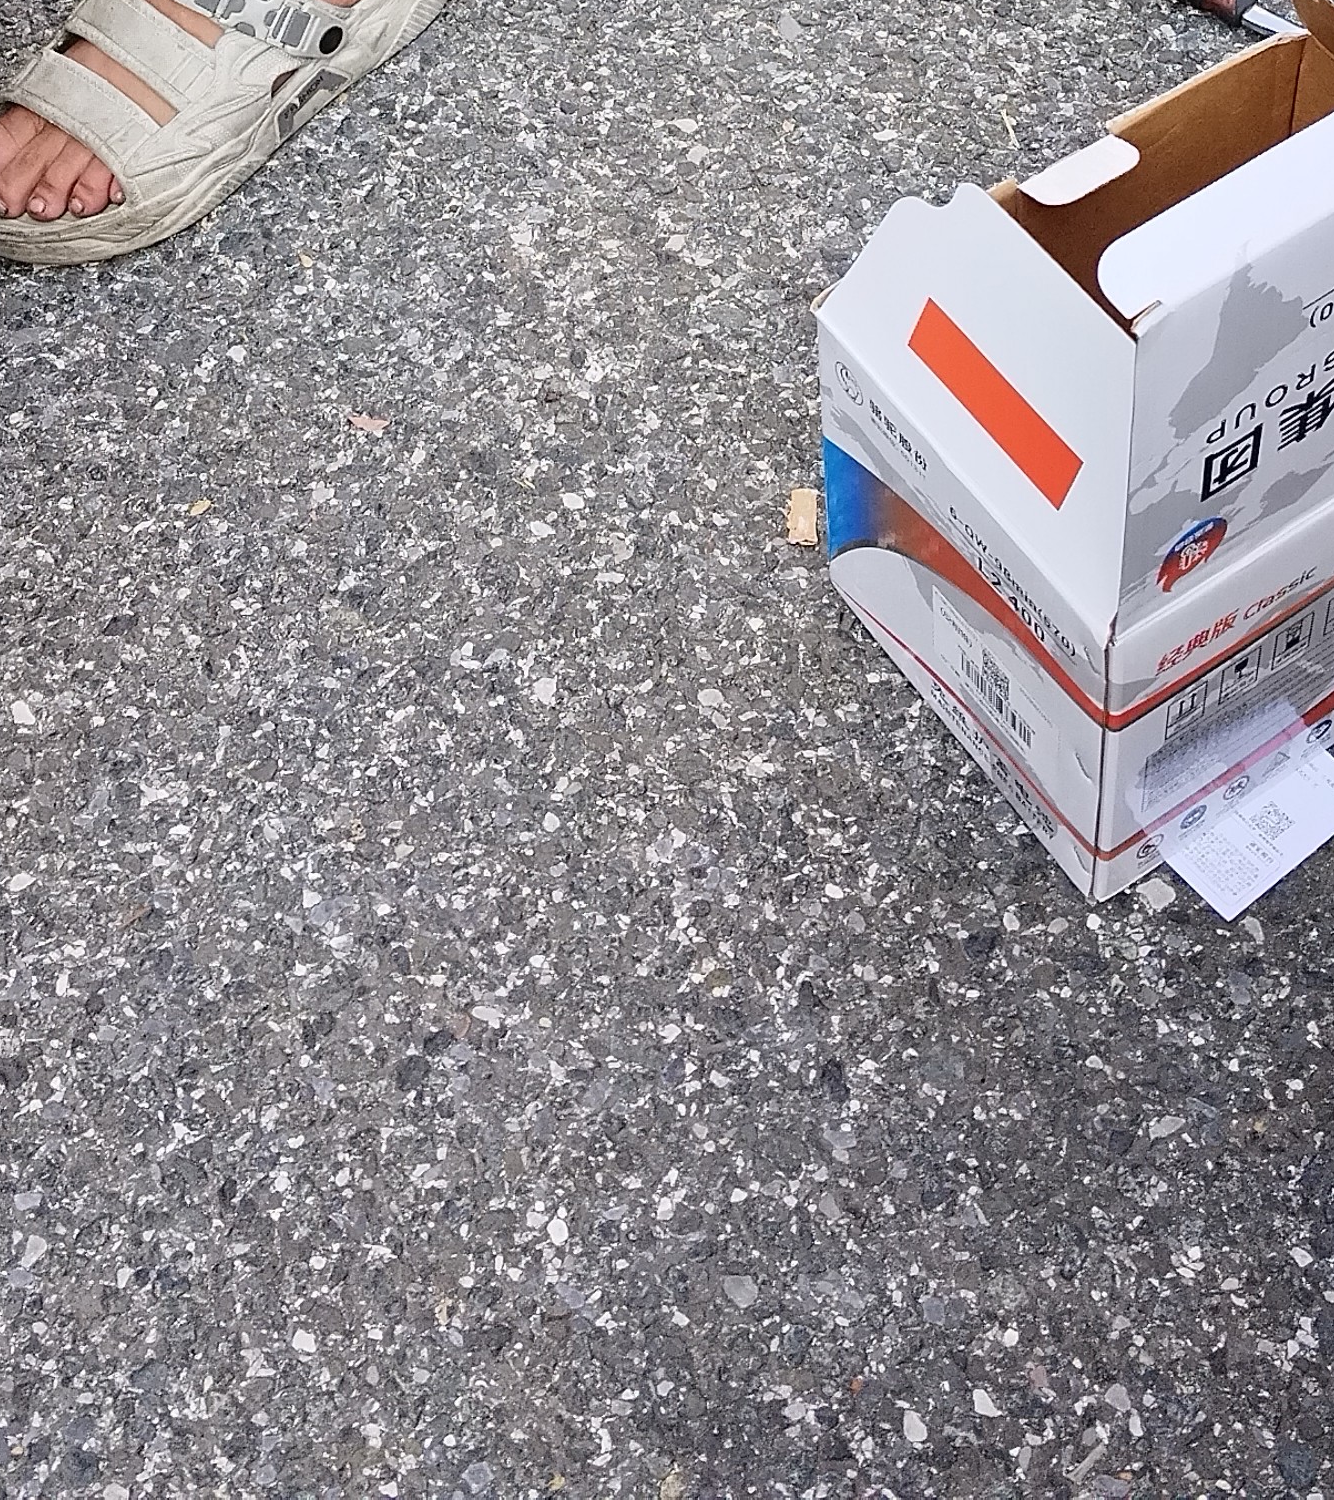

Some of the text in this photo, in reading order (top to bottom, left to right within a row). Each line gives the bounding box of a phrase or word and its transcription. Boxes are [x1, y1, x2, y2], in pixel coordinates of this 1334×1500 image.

[869, 399, 927, 470] 骆驼股份
[977, 556, 1044, 643] L2 400
[1157, 610, 1238, 675] 经典版
[1244, 567, 1315, 619] Classic
